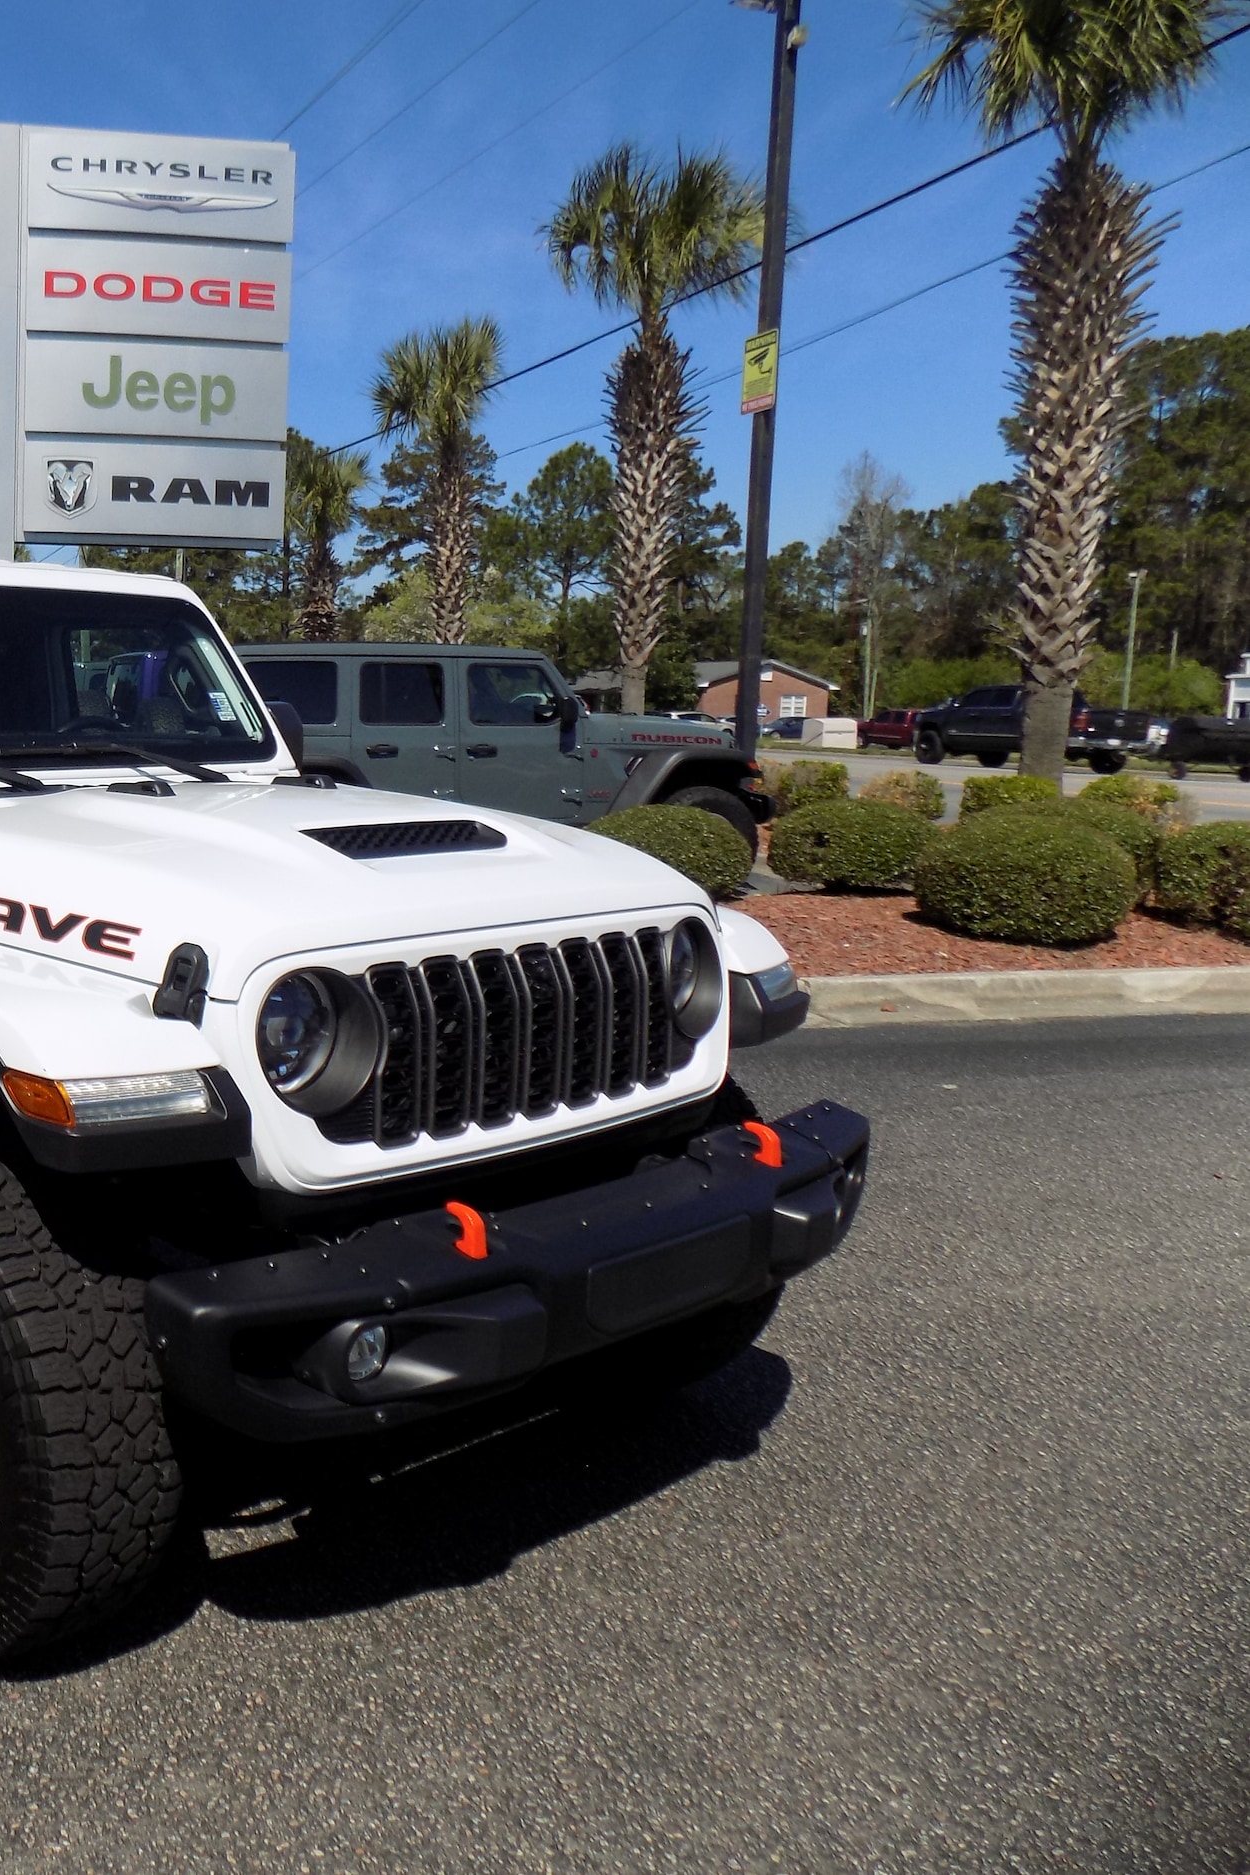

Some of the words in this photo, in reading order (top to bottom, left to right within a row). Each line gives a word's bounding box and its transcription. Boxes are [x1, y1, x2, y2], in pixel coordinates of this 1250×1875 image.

[51, 157, 273, 185] CHRYSLER
[44, 270, 276, 311] DODGE
[82, 355, 236, 425] Jeep
[111, 475, 270, 507] RAM
[631, 733, 723, 745] RUBICON
